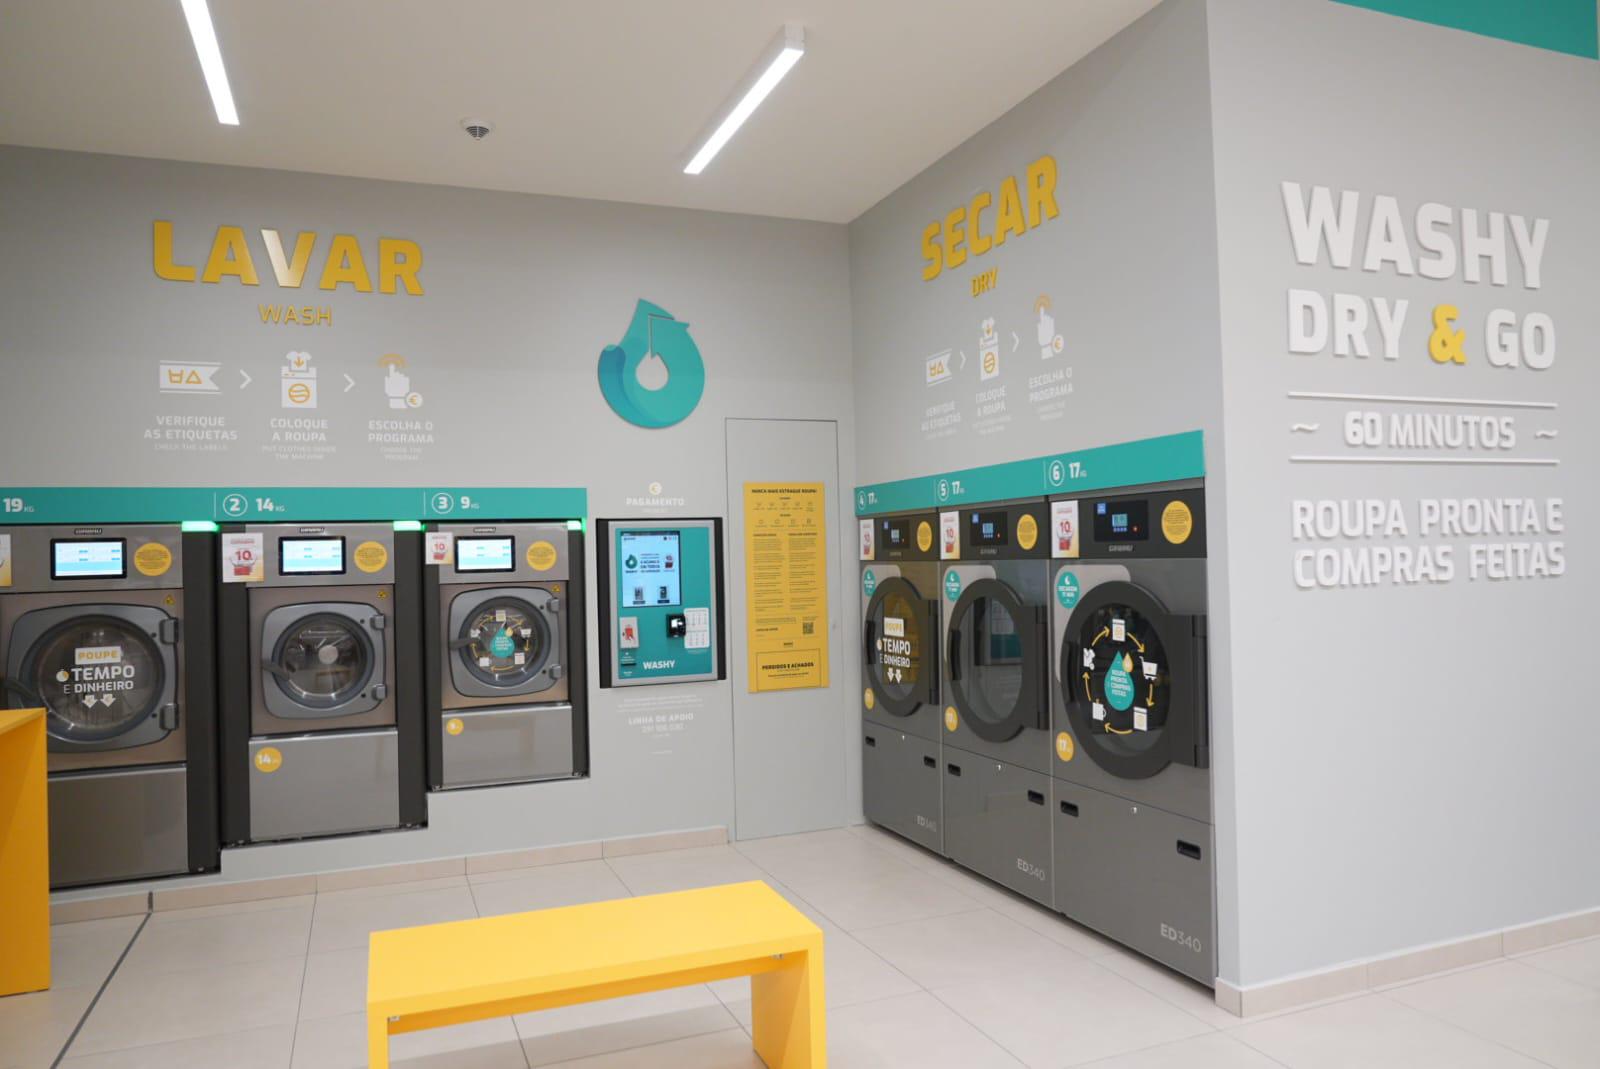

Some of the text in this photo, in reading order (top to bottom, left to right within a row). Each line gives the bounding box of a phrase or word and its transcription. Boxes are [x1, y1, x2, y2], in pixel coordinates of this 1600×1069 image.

[921, 154, 1059, 281] SECAR
[1280, 180, 1551, 290] WASHY
[152, 219, 425, 296] LAVAR
[971, 267, 998, 298] DRY
[258, 303, 333, 326] WASH
[1287, 288, 1556, 371] DRY & GO
[156, 415, 226, 428] VERIFIQUE
[270, 418, 329, 430] COLOQUE
[368, 420, 433, 432] ESCOLHA O
[144, 428, 238, 441] AS ETIQUETAS
[272, 432, 327, 443] A ROUPA
[368, 432, 434, 444] PROGRAMA
[1345, 411, 1517, 450] 60 MINUTOS
[1053, 465, 1060, 481] 6
[1069, 462, 1081, 479] 17
[940, 484, 947, 497] 5
[952, 481, 960, 495] 17
[4, 497, 23, 513] 19
[229, 498, 240, 512] 2
[256, 498, 274, 512] 14
[439, 496, 448, 510] 3
[460, 496, 470, 510] 9
[625, 497, 685, 506] PAGAMENTO
[1292, 498, 1564, 541] ROUPA PRONTA E
[1293, 541, 1566, 591] COMPRAS FEITAS
[882, 637, 911, 656] TEMPO
[78, 650, 119, 660] POUPE
[884, 654, 911, 668] DINHEIRO
[71, 664, 135, 681] TEMPO
[642, 659, 676, 670] WASHY
[63, 680, 134, 694] E DINHEIRO
[668, 712, 694, 721] APOIO
[1017, 858, 1046, 881] ED340
[1161, 923, 1202, 952] ED340
